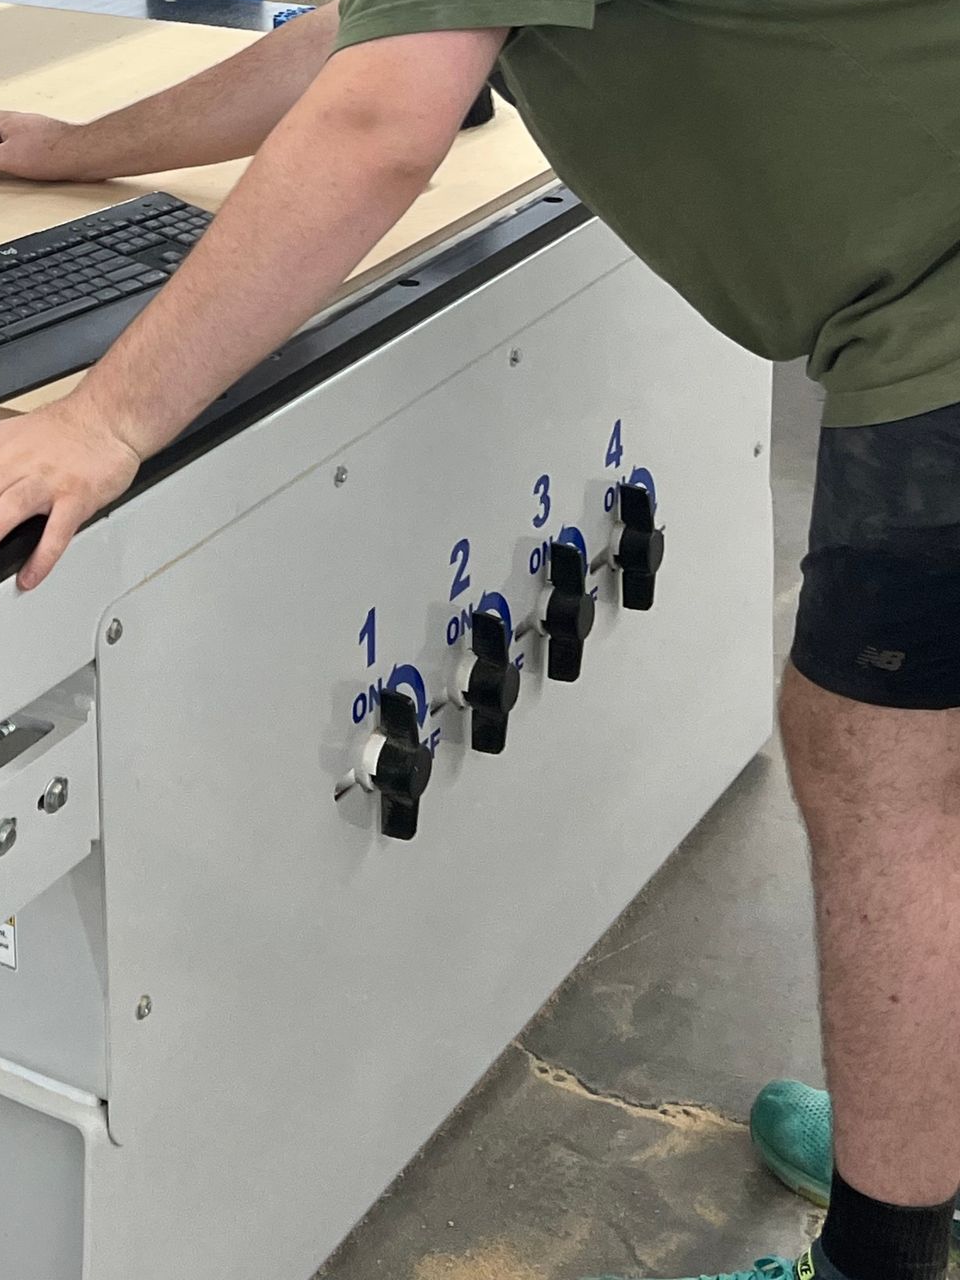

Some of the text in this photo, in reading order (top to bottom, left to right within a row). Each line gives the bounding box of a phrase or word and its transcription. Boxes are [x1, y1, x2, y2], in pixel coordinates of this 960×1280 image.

[605, 418, 623, 469] 4
[532, 474, 551, 528] 3
[449, 538, 470, 601] 2
[359, 606, 376, 668] 1
[447, 602, 473, 645] ON
[353, 677, 382, 725] ON
